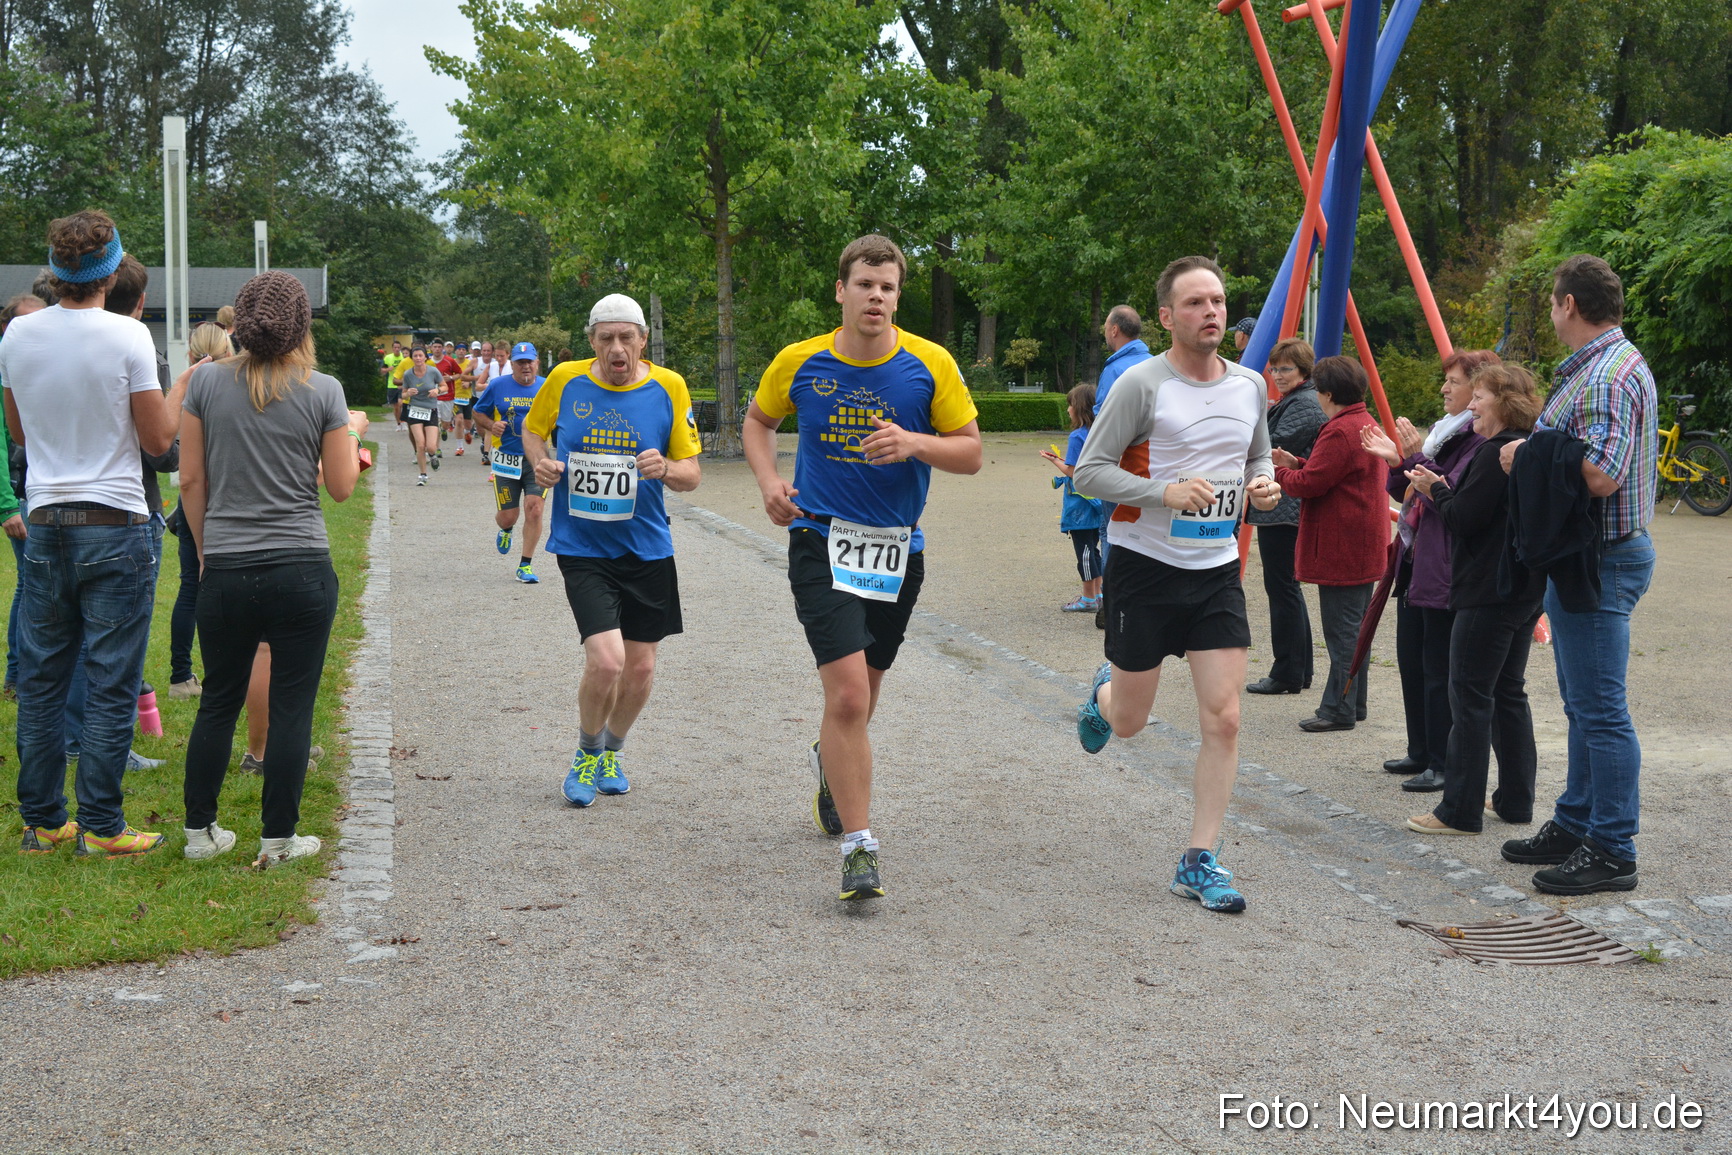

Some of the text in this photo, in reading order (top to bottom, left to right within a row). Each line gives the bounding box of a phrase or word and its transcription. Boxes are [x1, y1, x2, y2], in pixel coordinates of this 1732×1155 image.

[411, 410, 429, 419] 2173
[494, 450, 520, 467] 2198
[569, 458, 625, 469] PARTL Neumarkt
[573, 468, 631, 497] 2570
[590, 501, 609, 512] Otto
[46, 511, 87, 525] PMA
[831, 525, 898, 541] PARTL Neumarkt
[1198, 525, 1220, 537] Sven
[836, 538, 901, 572] 2170
[850, 575, 885, 589] Patrick
